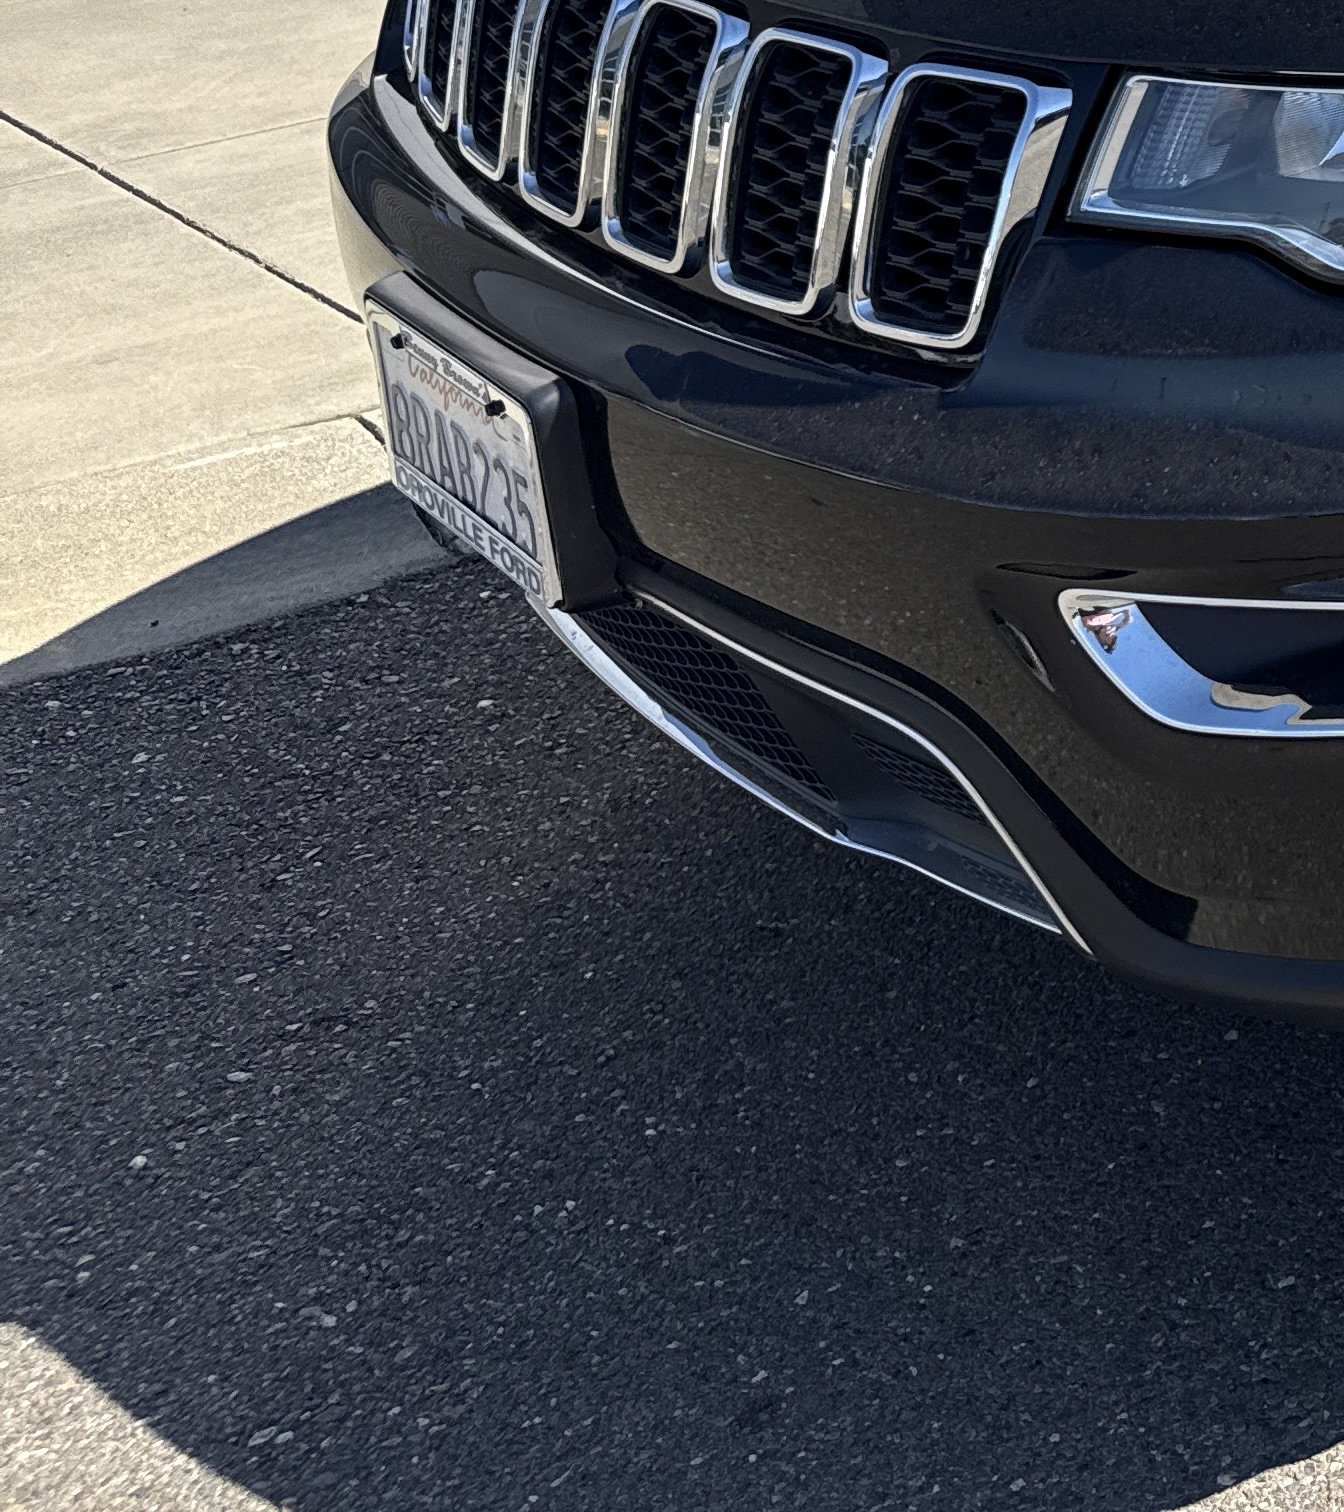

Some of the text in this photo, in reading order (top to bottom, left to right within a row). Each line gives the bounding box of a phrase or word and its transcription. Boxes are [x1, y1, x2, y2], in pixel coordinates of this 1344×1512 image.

[391, 383, 537, 560] 8RAB235
[395, 464, 542, 596] OROVILLE FORD
